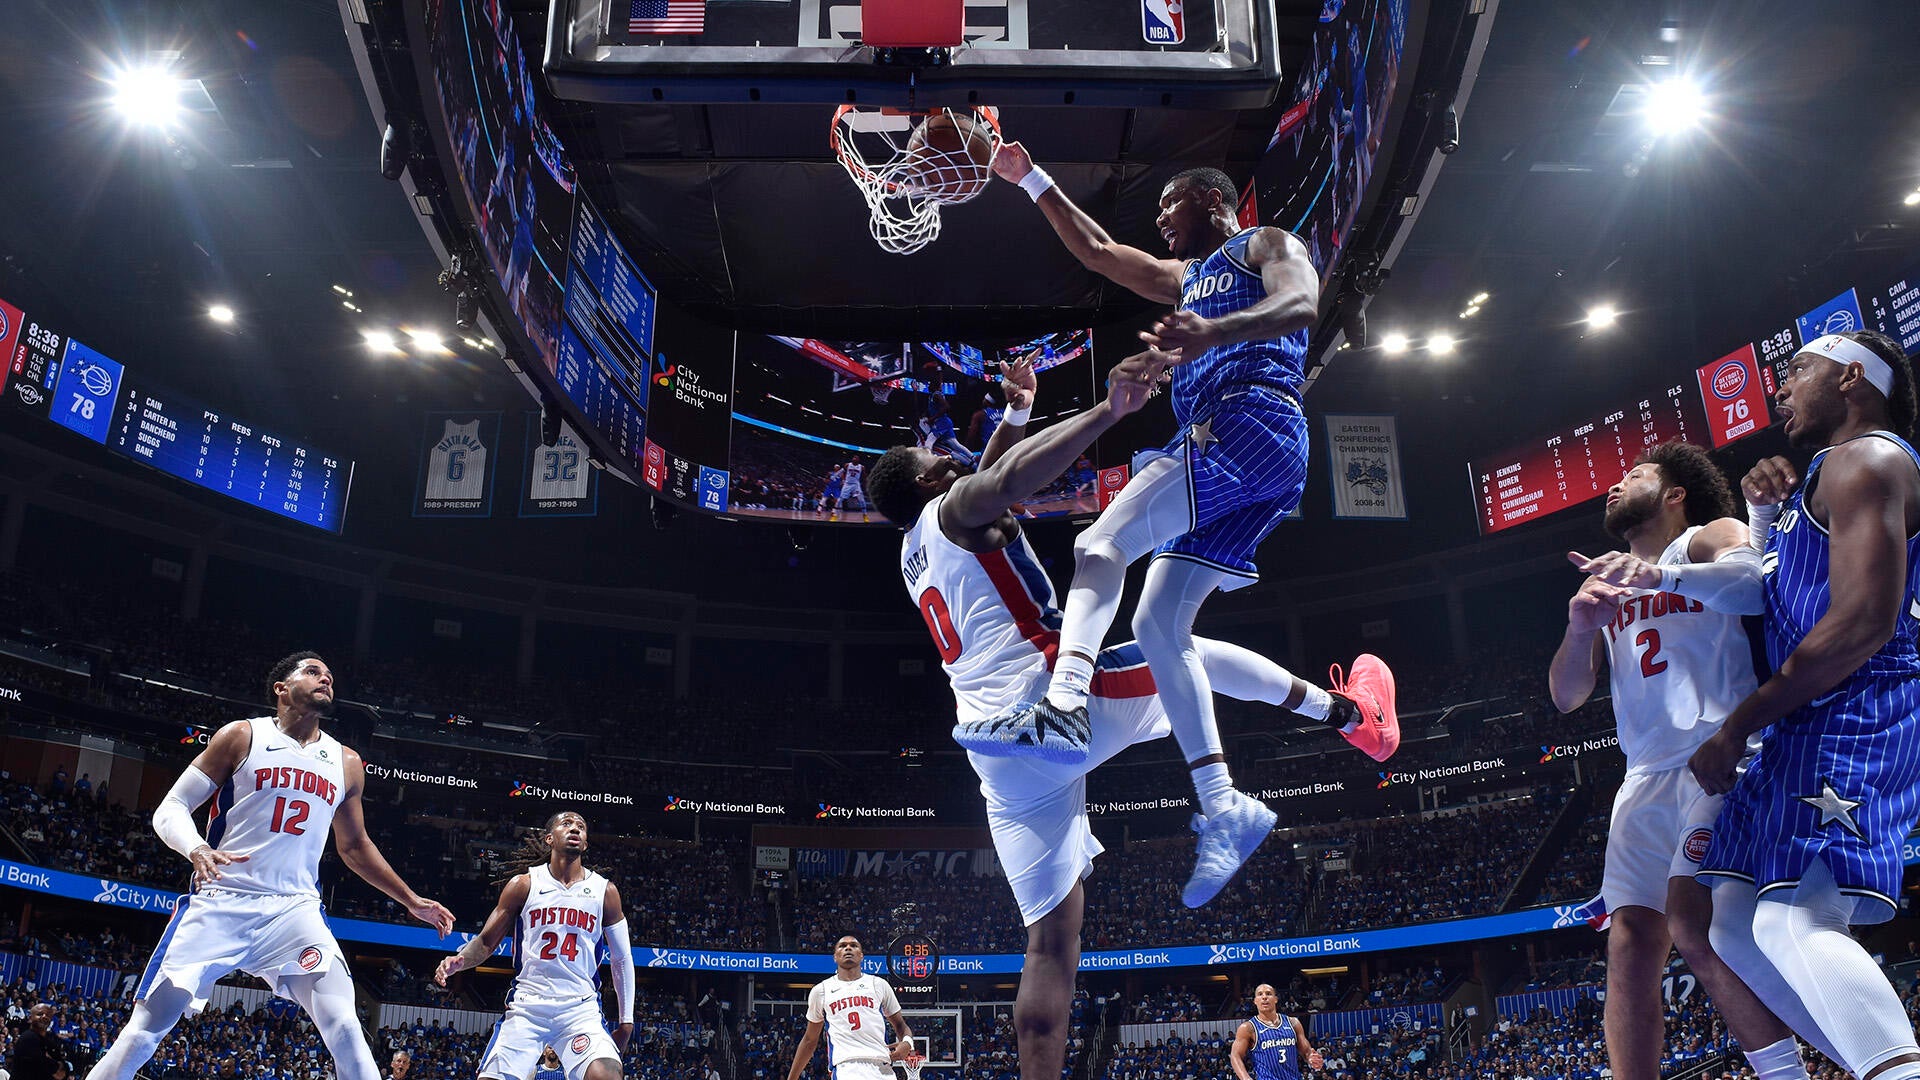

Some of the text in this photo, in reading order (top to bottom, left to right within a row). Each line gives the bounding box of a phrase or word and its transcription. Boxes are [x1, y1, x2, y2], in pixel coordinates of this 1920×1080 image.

[1150, 26, 1170, 39] NBA
[1889, 280, 1906, 297] CAIN
[1876, 288, 1920, 319] 34 CARTER
[29, 323, 59, 348] 8:36
[1762, 329, 1792, 354] 8:36
[27, 337, 56, 356] 4TH QTR
[1765, 343, 1794, 361] 4TH QTR
[30, 362, 41, 373] TOL
[32, 353, 57, 371] FLS 5
[1776, 359, 1788, 371] FLS
[15, 363, 40, 382] 0 CHL
[677, 365, 699, 384] City
[1719, 371, 1739, 383] DETROIT
[1765, 377, 1771, 385] 2
[1778, 369, 1788, 378] TO
[15, 383, 31, 396] Hard
[676, 377, 727, 403] National
[1720, 377, 1741, 390] PISTONS
[71, 392, 95, 419] 78
[676, 389, 704, 409] Bank
[1547, 385, 1682, 448] PTS REBS ASTS FG FLS
[1723, 399, 1749, 425] 76
[131, 391, 331, 478] 8 CAIN 2/7 3
[1334, 435, 1391, 443] CONFERENCE
[1342, 425, 1380, 433] EASTERN
[1730, 422, 1751, 436] BONUS
[128, 402, 329, 489] 34 CARTER JR. 10 3/6 2
[204, 411, 337, 468] PTS REBS ASTS FG FLS
[1482, 474, 1490, 483] 24
[1497, 463, 1522, 477] JENKINS
[1641, 411, 1651, 421] 1/5
[141, 420, 175, 442] BANCHERO
[262, 470, 267, 478] 4
[288, 480, 301, 490] 3/15
[674, 458, 688, 470] 8:36
[1498, 422, 1653, 489] DUREN 12 3 5/7
[138, 432, 298, 501] SUGGS 1 0/8
[447, 451, 466, 482] 6
[544, 451, 578, 482] 32
[648, 465, 657, 479] 76
[1486, 496, 1492, 504] 12
[1500, 486, 1523, 500] HARRIS
[1644, 433, 1657, 445] 6/14
[120, 437, 323, 521] 3 BANE 19 6/13 3
[706, 491, 719, 502] 78
[1502, 490, 1544, 511] CUNNINGHAM
[1559, 482, 1566, 490] 23
[1504, 503, 1538, 521] THOMPSON
[904, 545, 929, 587] DUREN
[919, 586, 962, 665] 0
[1635, 628, 1668, 678] 2
[1554, 736, 1618, 759] City Natio
[366, 764, 478, 789] City National Bank
[1391, 758, 1505, 784] City National Bank
[255, 767, 337, 806] PISTONS
[525, 786, 633, 805] City National Bank
[1262, 781, 1344, 799] National Bank
[270, 796, 310, 835] 12
[679, 800, 785, 814] City National Bank
[830, 807, 935, 819] City National Bank
[1084, 797, 1189, 814] City National Bank
[797, 850, 826, 864] 110A
[8, 866, 50, 888] Bank
[118, 888, 149, 906] City
[529, 907, 597, 933] PISTONS
[540, 932, 579, 962] 24
[905, 944, 929, 956] 8:36
[1227, 937, 1361, 961] City National Bank
[667, 953, 798, 969] City National Bank
[908, 957, 926, 977] 16
[949, 959, 984, 970] Bank
[1135, 953, 1170, 964] Bank
[829, 995, 874, 1015] PISTONS
[848, 1011, 860, 1031] 9
[1279, 1050, 1286, 1063] 3
